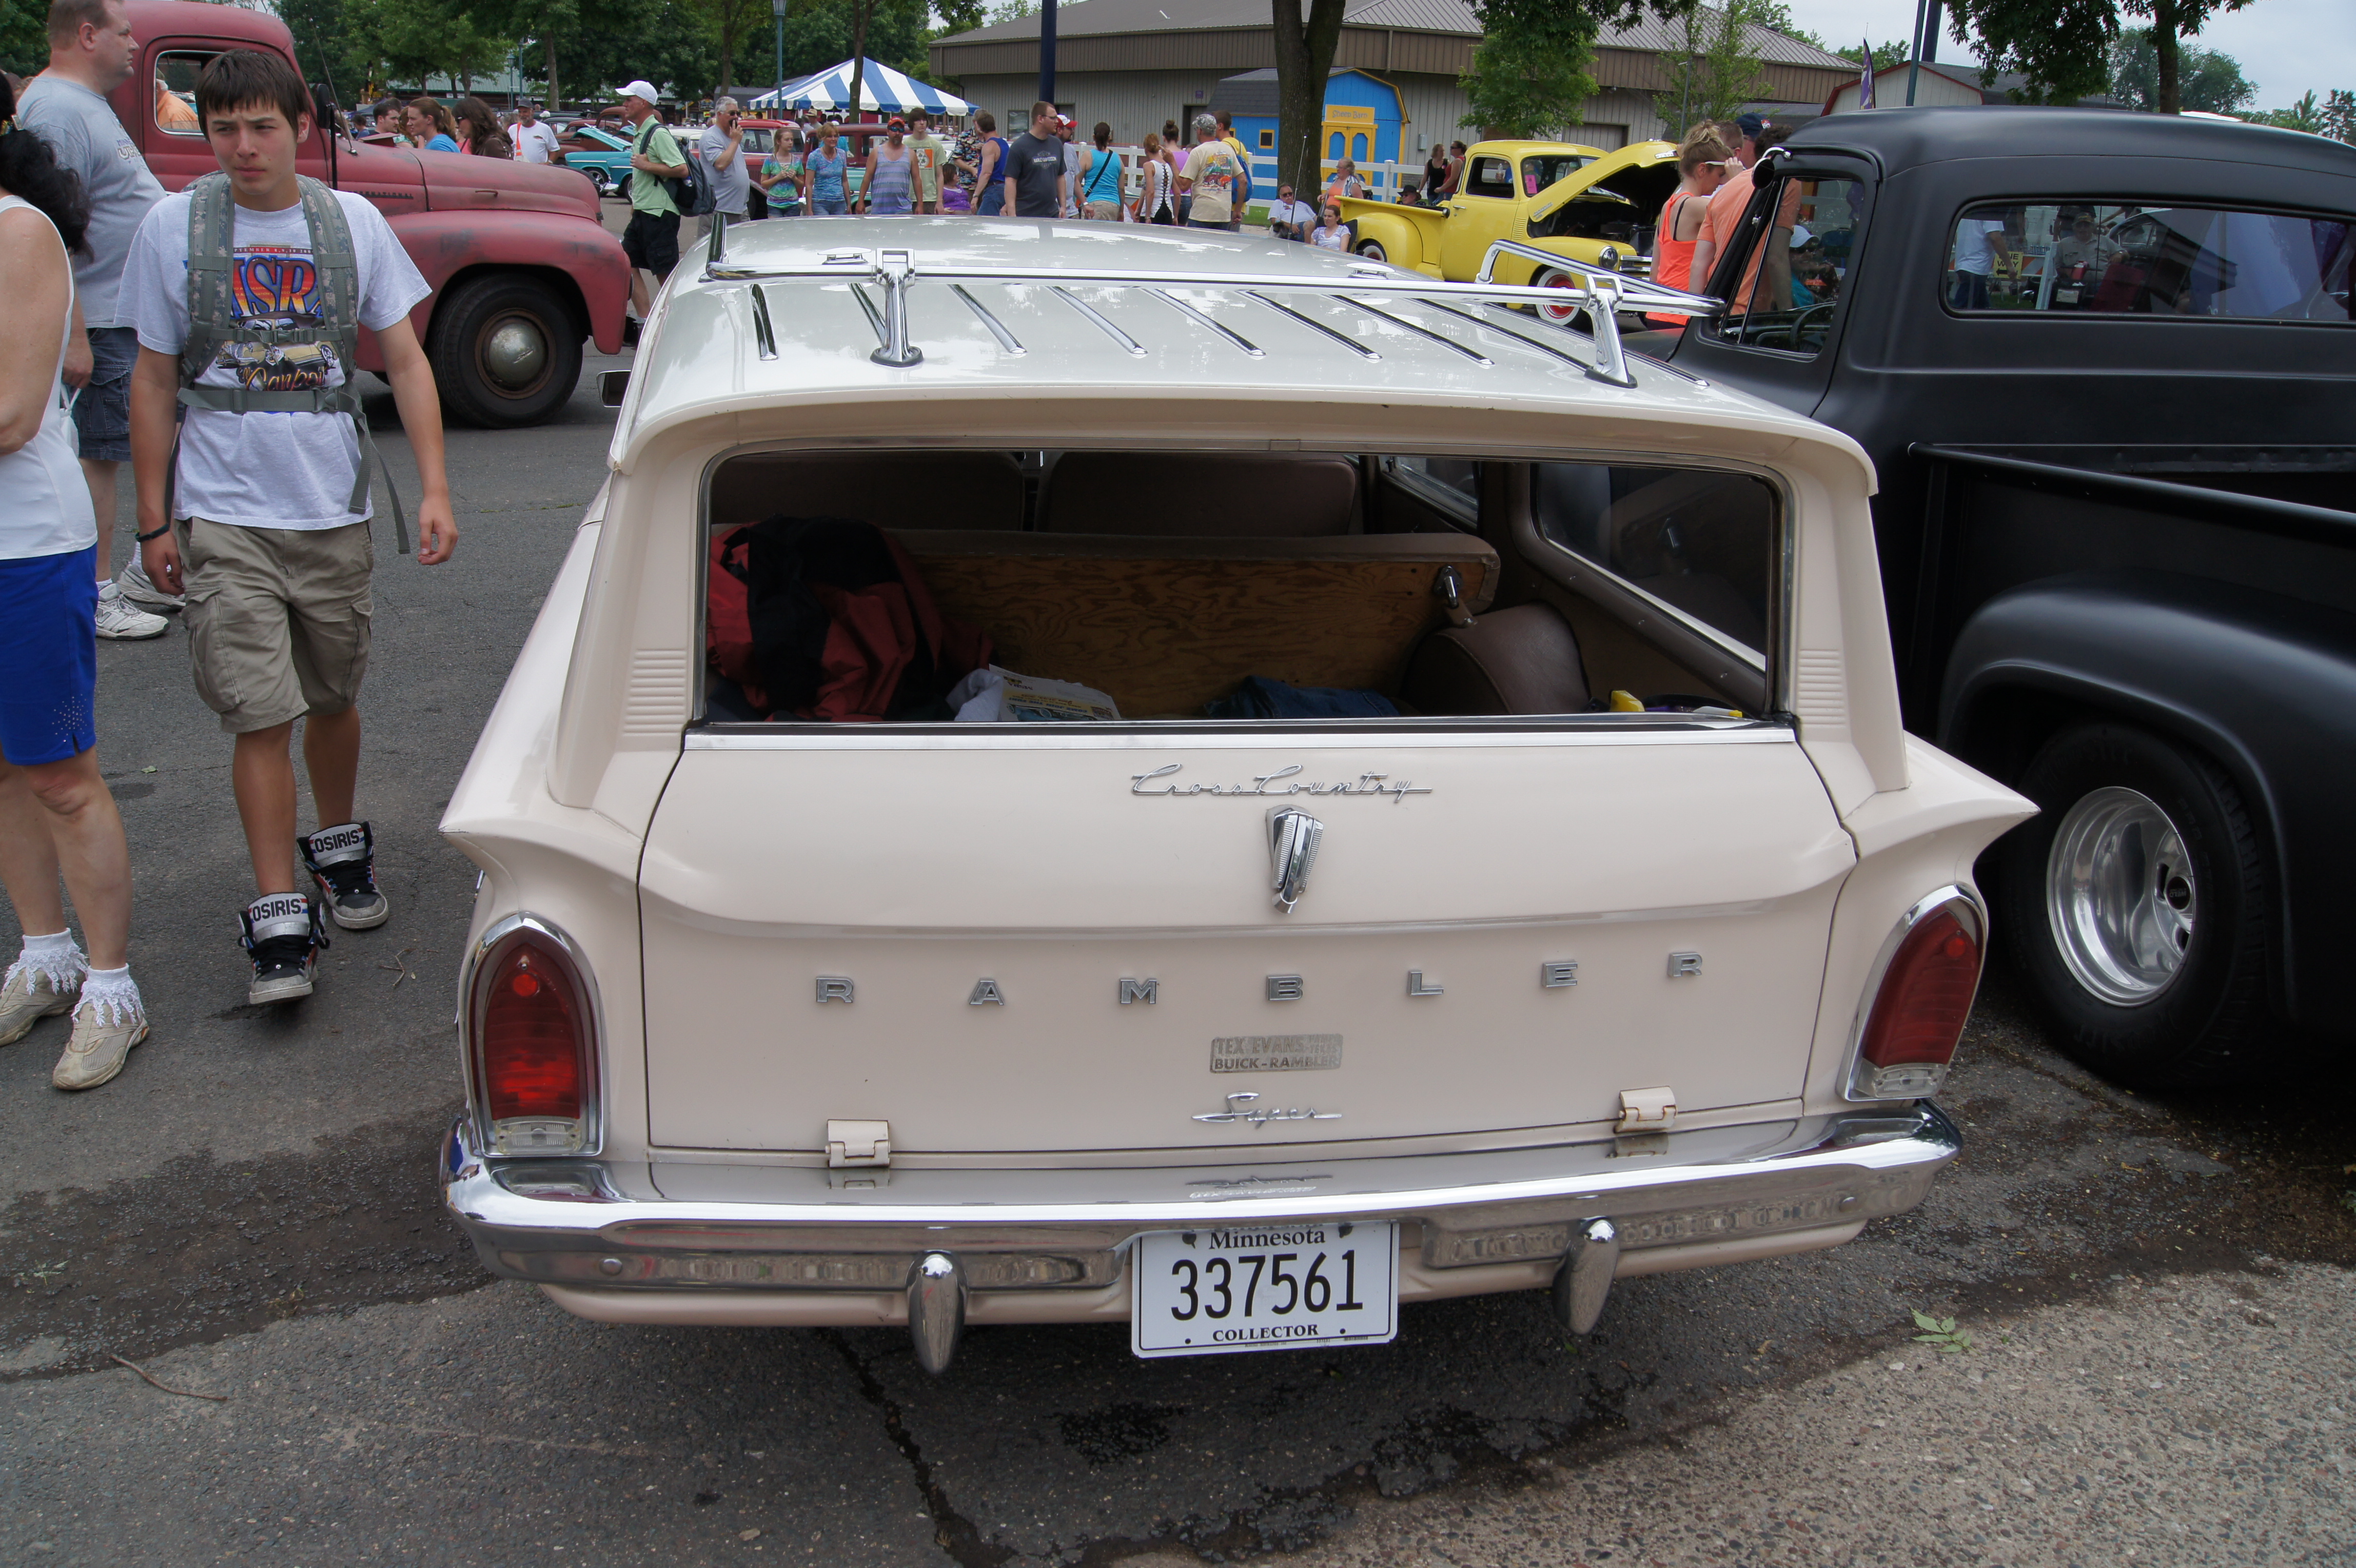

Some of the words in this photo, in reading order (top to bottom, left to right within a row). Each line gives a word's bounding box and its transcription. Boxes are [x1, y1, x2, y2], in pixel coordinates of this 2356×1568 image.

[1332, 110, 1352, 118] Sheep
[1353, 110, 1368, 119] Barn
[314, 829, 360, 853] OSIRIS
[252, 898, 302, 922] OSIRIS
[1218, 1037, 1245, 1054] TEX
[1252, 1035, 1304, 1054] EVANS
[1209, 1228, 1326, 1249] Minnesota
[1171, 1250, 1363, 1321] 337561
[1212, 1324, 1319, 1342] COLLECTOR
